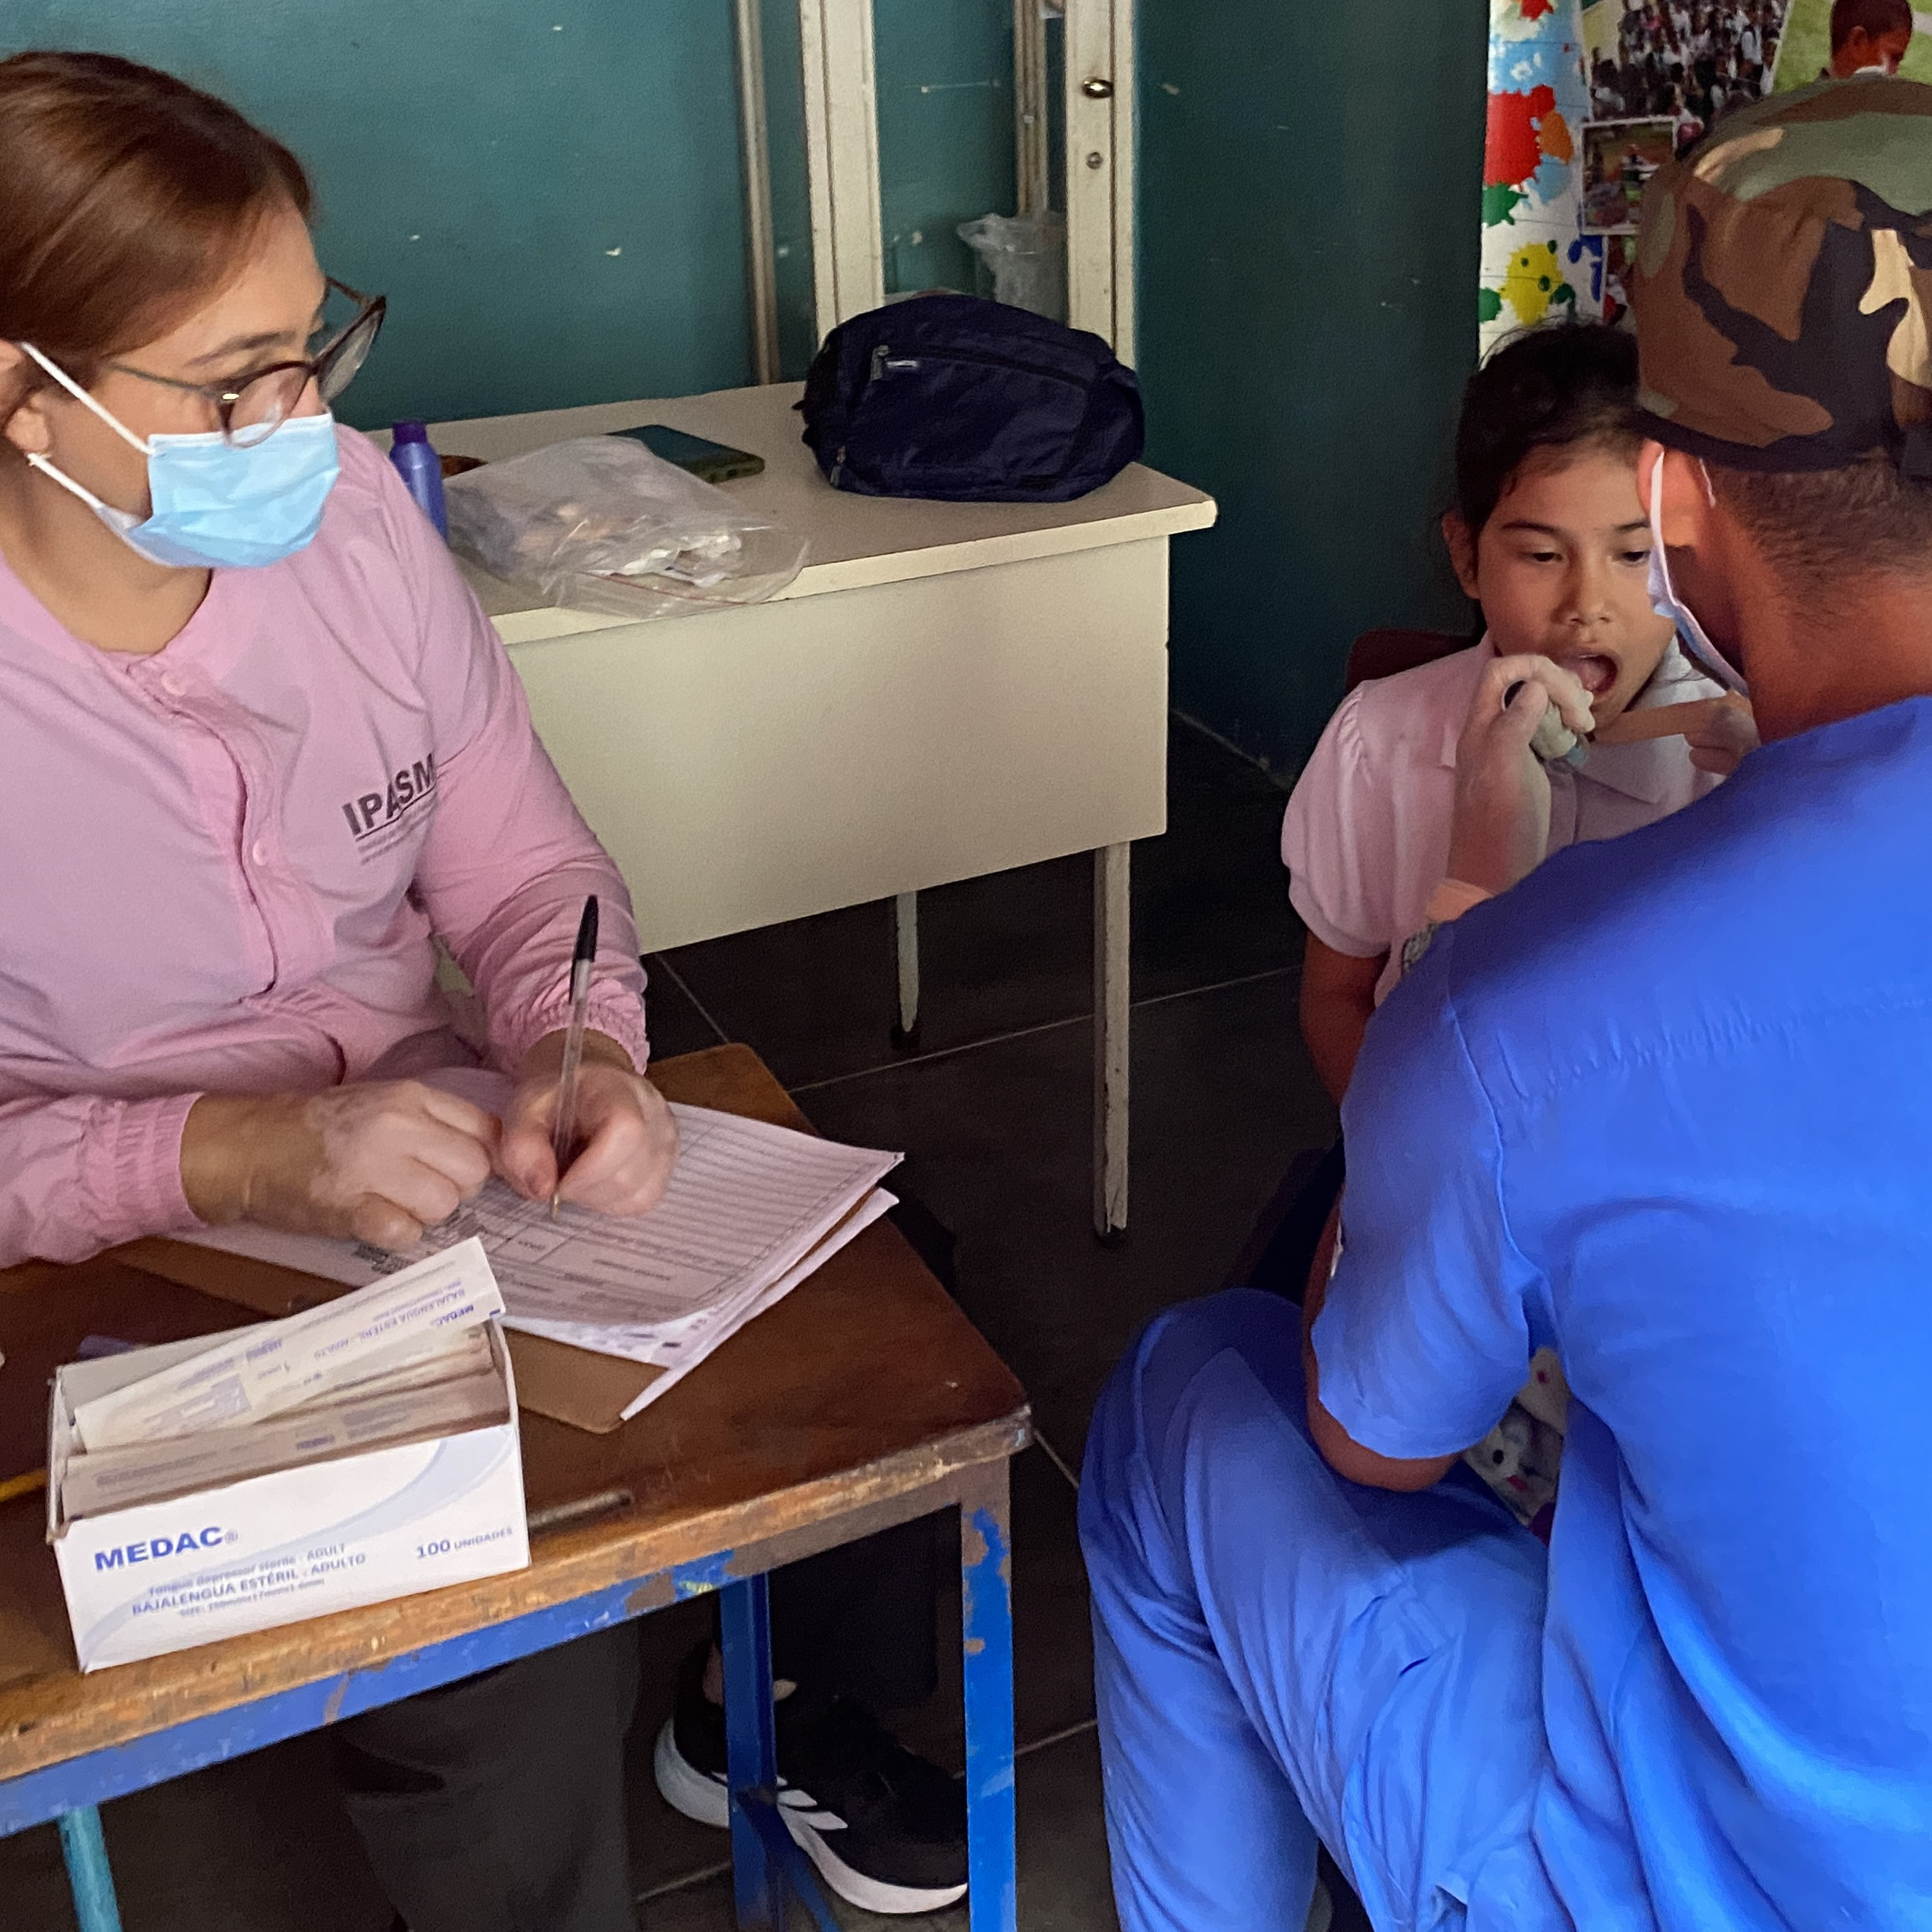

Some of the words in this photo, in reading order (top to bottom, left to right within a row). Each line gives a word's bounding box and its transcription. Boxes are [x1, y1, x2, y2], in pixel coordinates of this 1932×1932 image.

[306, 1543, 345, 1561] ADULT
[417, 1539, 451, 1559] 100
[453, 1526, 514, 1551] UNIDADES
[131, 1582, 237, 1616] BAJALENGUA
[239, 1569, 299, 1591] ESTÉRIL
[310, 1553, 366, 1576] ADULTO
